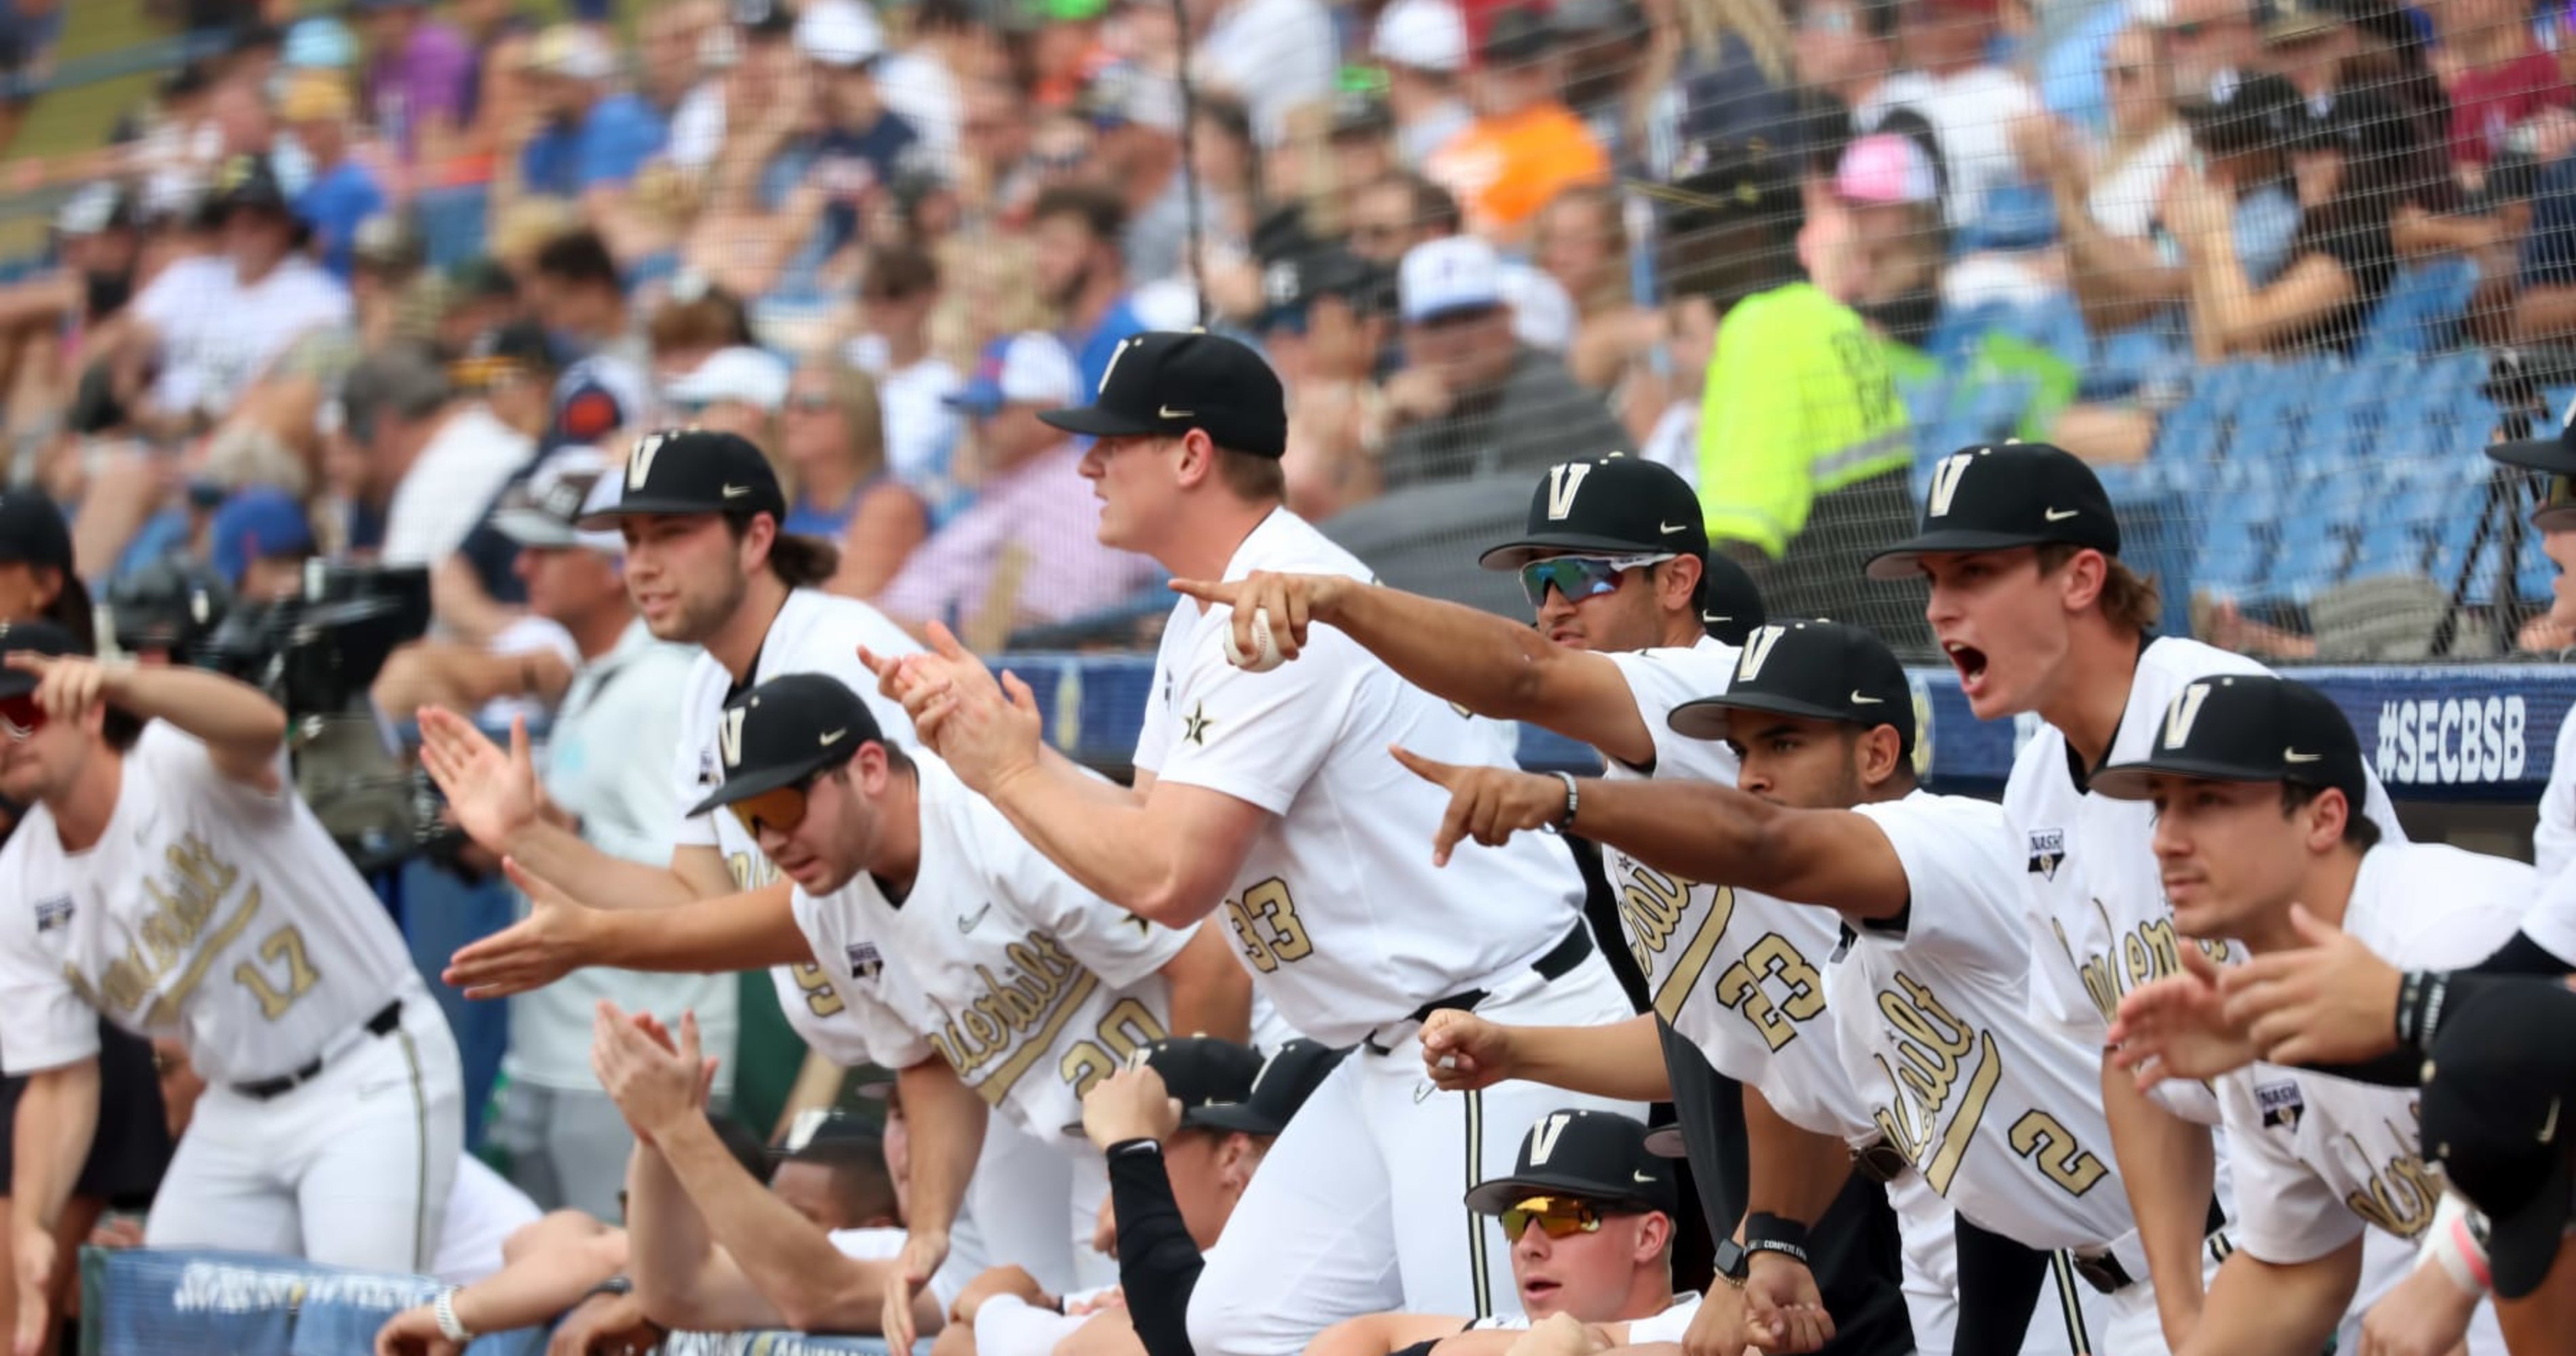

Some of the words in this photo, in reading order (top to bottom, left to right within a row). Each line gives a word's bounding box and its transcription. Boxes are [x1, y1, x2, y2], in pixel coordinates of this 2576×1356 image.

[629, 434, 664, 491] V
[1548, 462, 1591, 521] V
[1930, 453, 1973, 517] V
[1737, 624, 1786, 682] V
[2164, 683, 2211, 750] V
[2377, 695, 2526, 784] #SECBSB
[233, 923, 322, 1021] 17
[1715, 931, 1827, 1054] 23
[1529, 1113, 1571, 1167] V
[2007, 1108, 2110, 1198] 2
